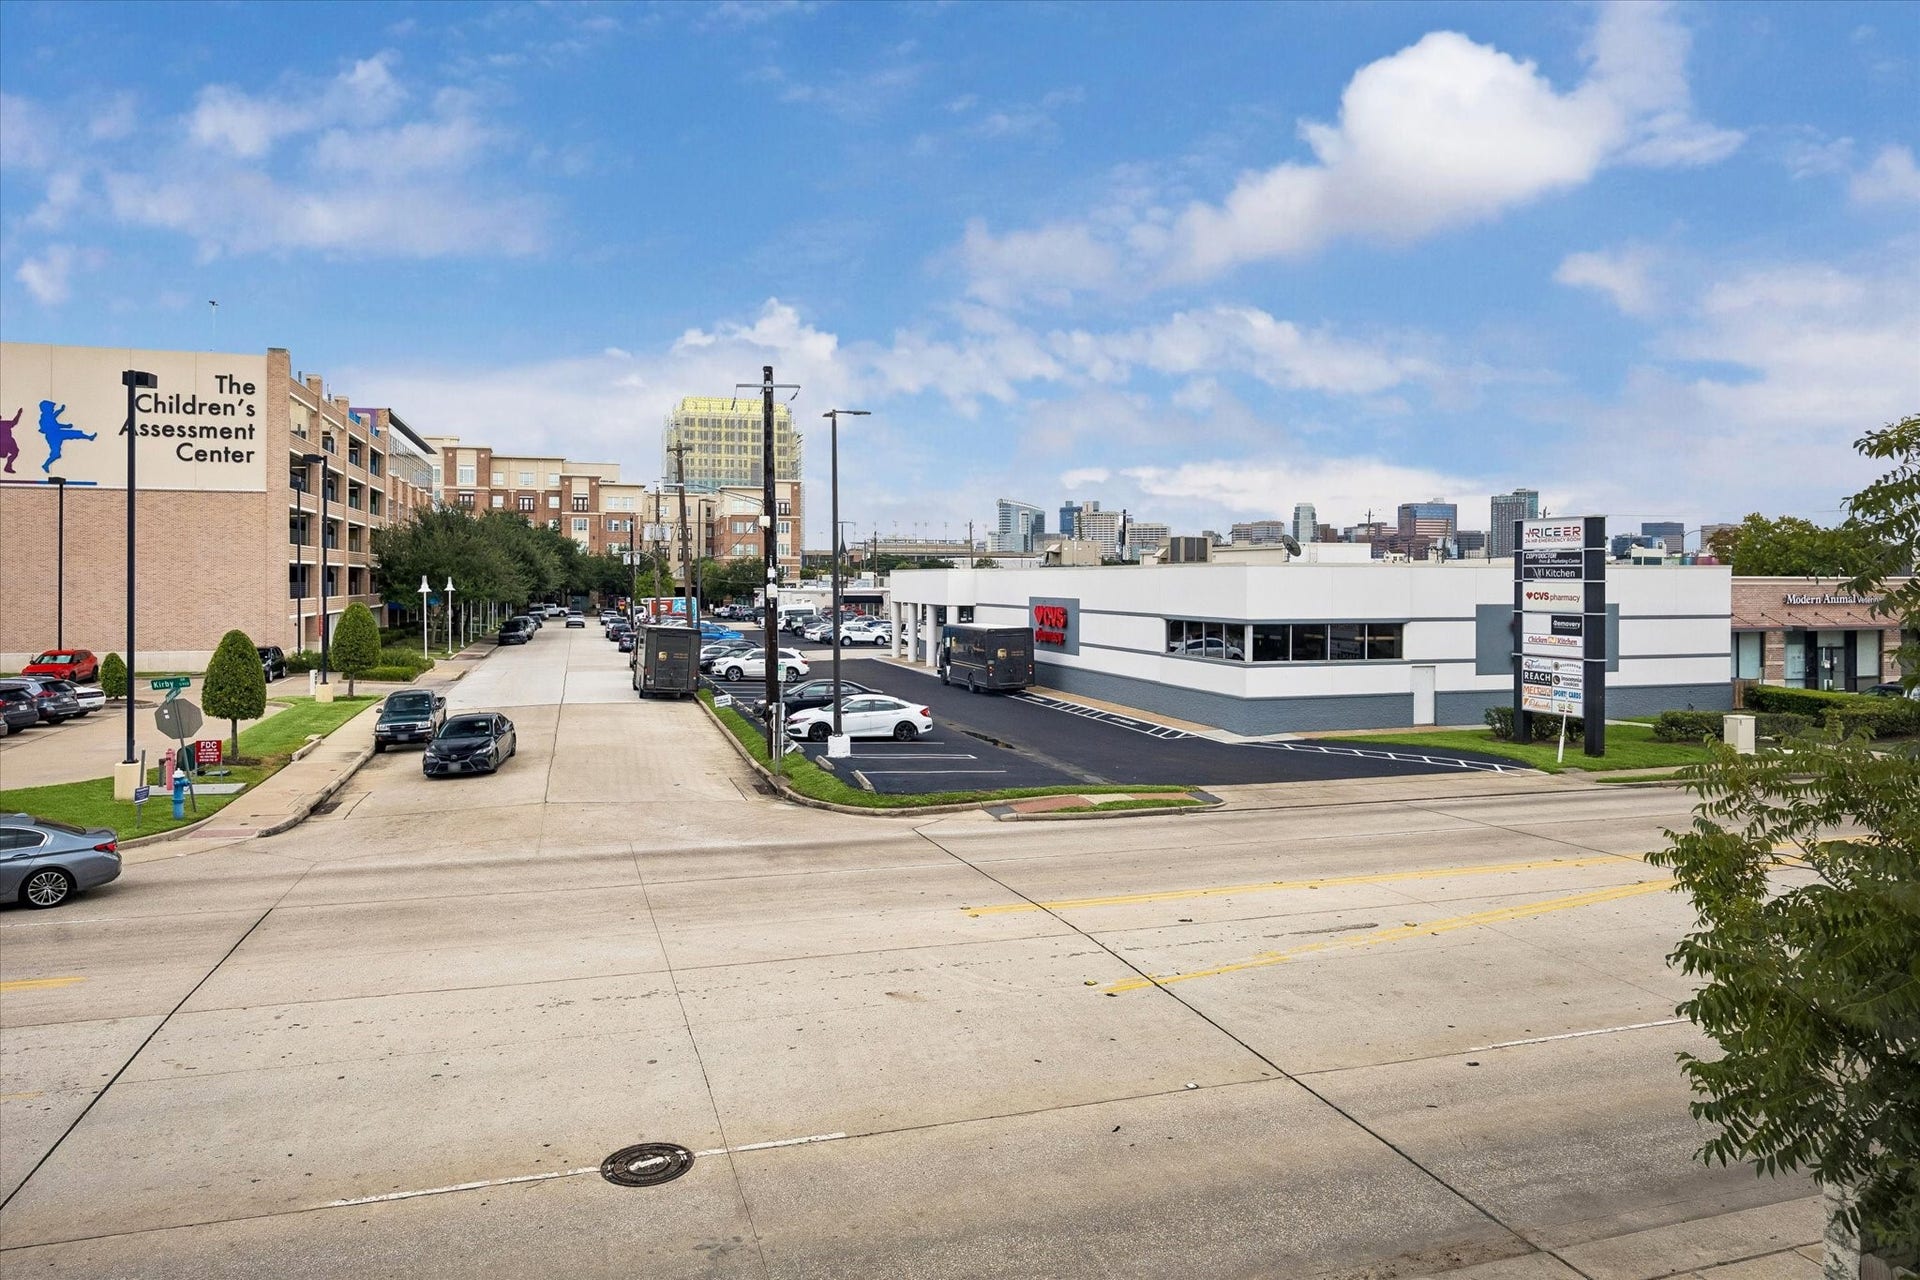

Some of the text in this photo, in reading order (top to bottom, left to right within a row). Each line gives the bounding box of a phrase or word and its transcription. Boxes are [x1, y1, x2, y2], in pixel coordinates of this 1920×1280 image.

[215, 374, 256, 395] The
[135, 393, 256, 417] Children's
[176, 442, 256, 463] Center
[1545, 569, 1575, 577] Kitchen
[1533, 592, 1580, 602] CVS pharmacy
[1786, 594, 1820, 604] Modern
[1823, 594, 1856, 604] Animal
[1043, 605, 1066, 628] CVS
[1528, 636, 1548, 644] Chicken
[1524, 671, 1551, 682] REACH
[153, 680, 174, 689] Kirby
[200, 741, 218, 749] FDC
